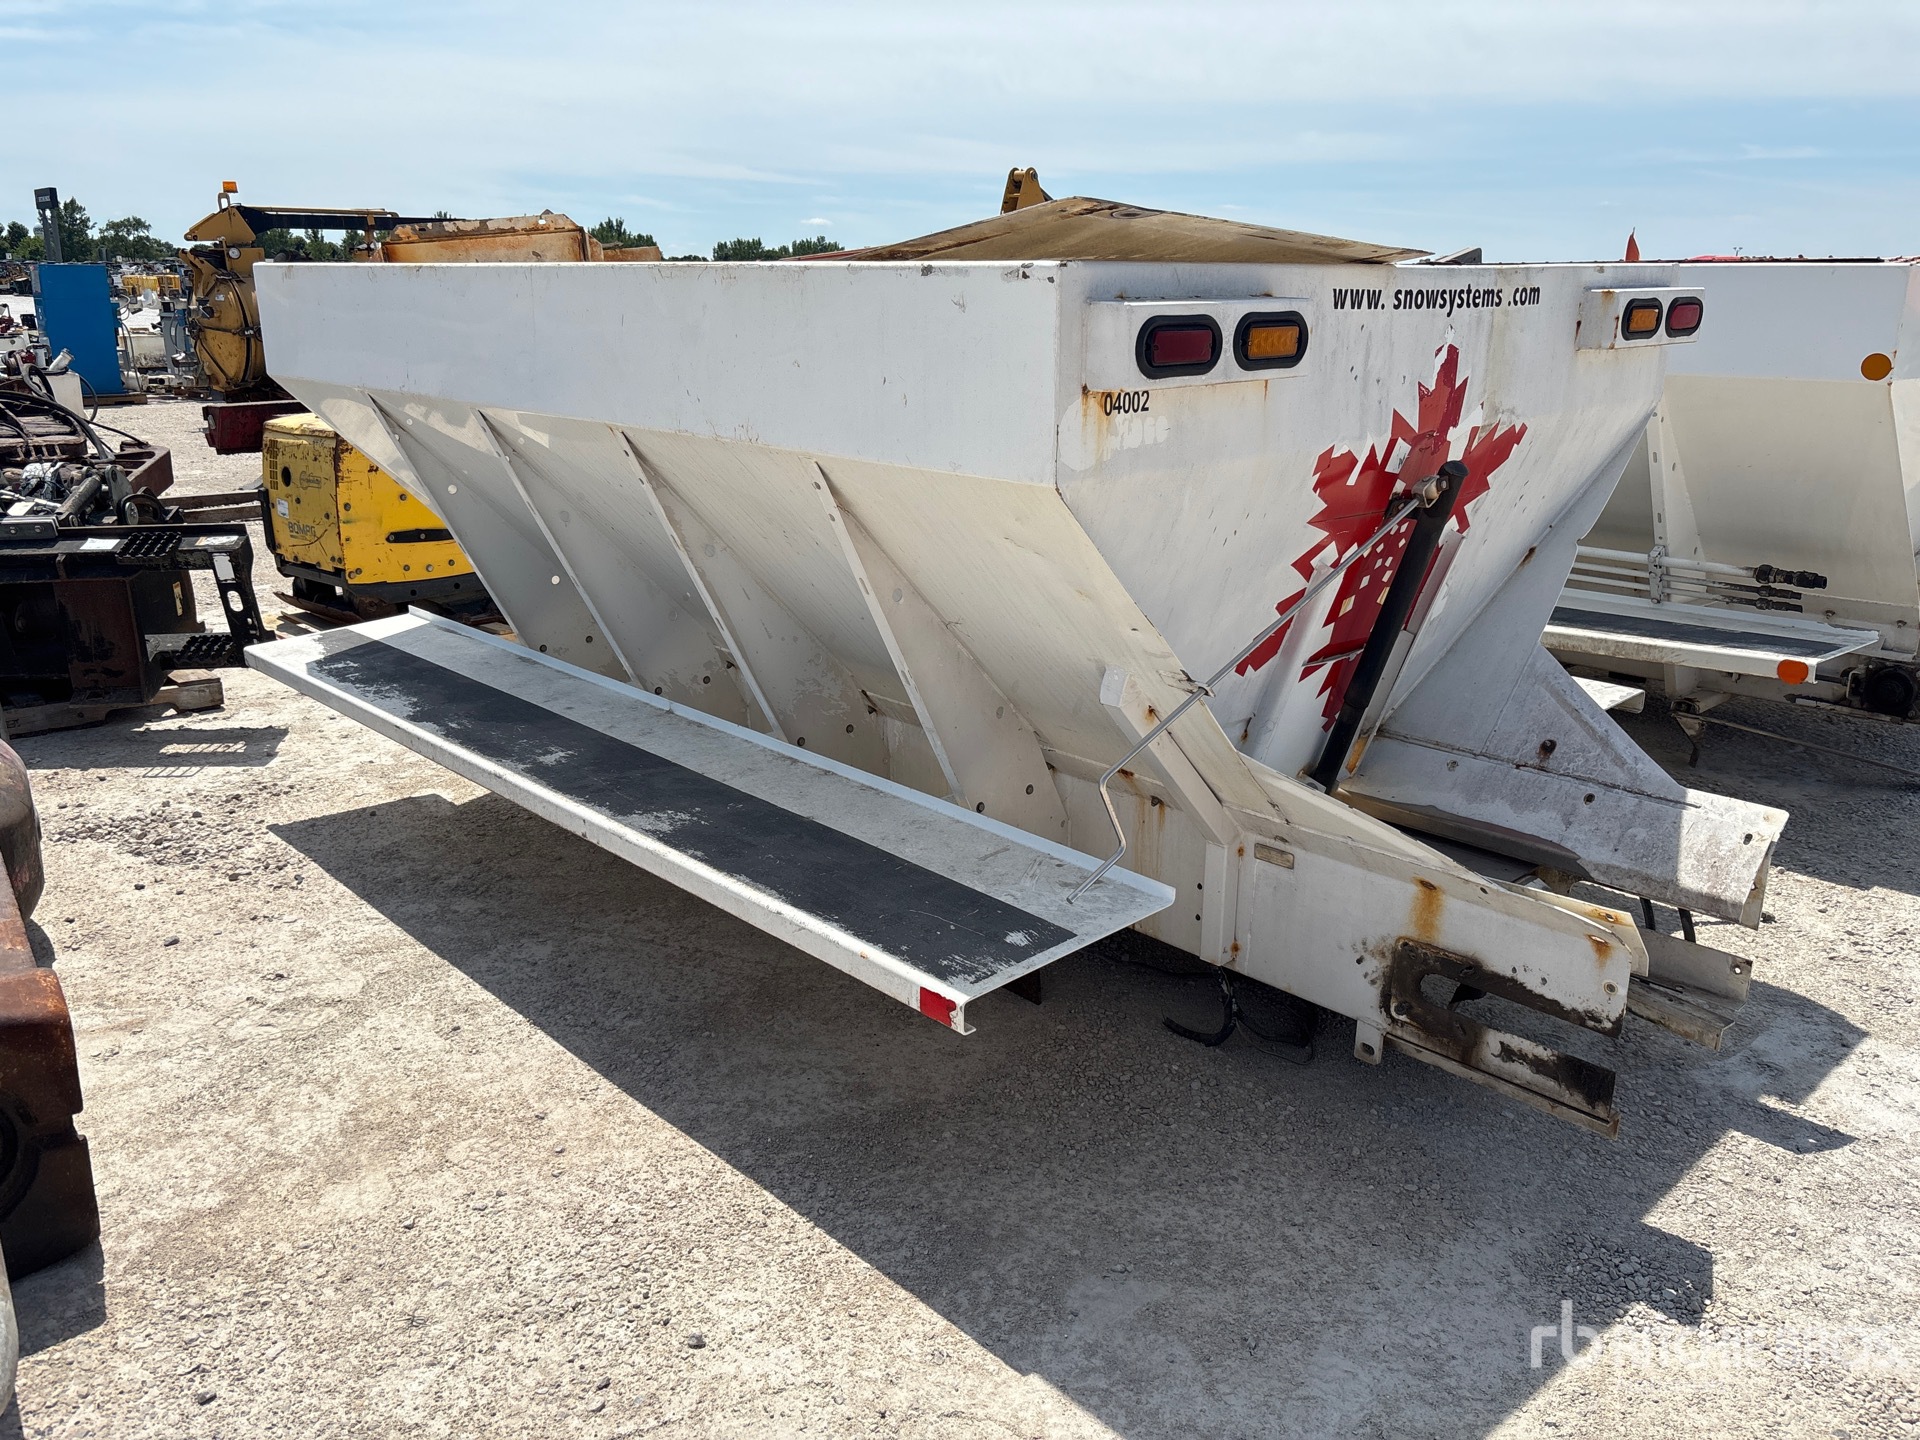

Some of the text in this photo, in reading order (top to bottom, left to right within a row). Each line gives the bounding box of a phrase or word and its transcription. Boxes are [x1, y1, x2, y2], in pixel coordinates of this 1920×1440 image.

[1332, 283, 1541, 318] www. snowsystems .com
[1103, 390, 1150, 417] 04002
